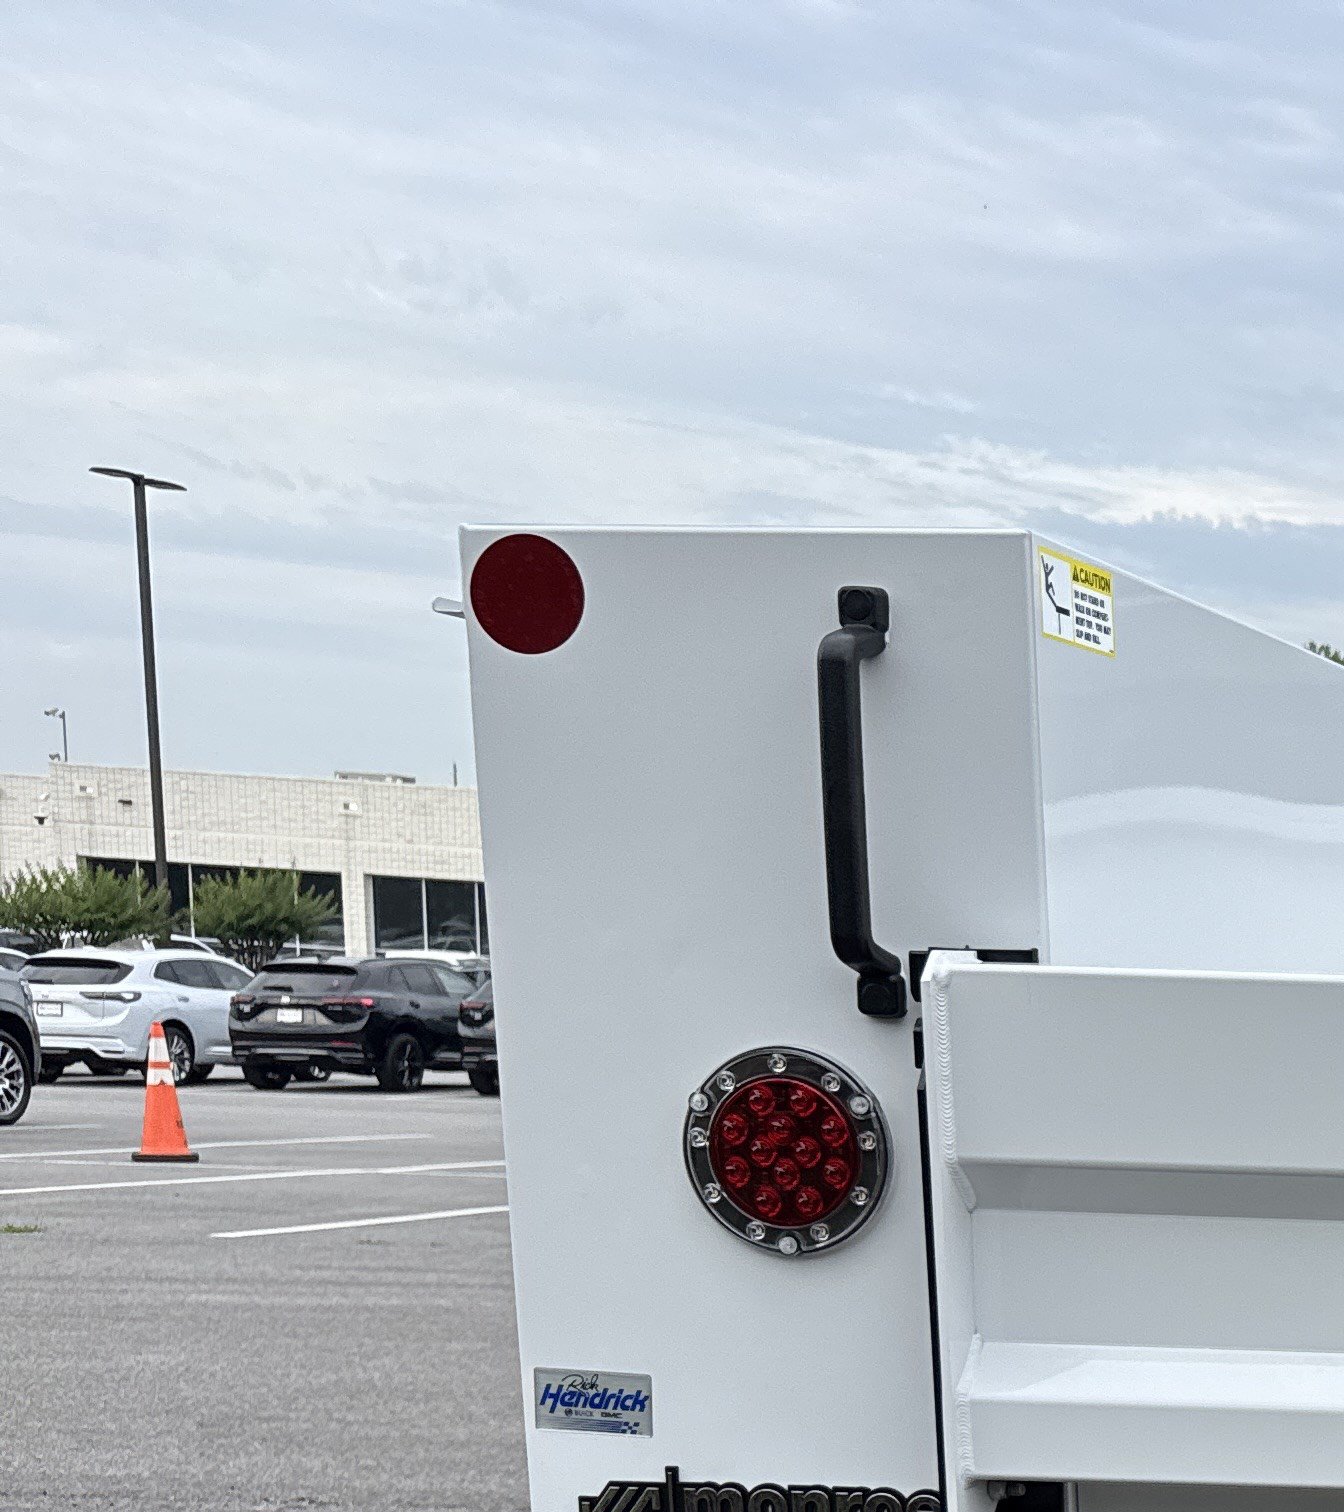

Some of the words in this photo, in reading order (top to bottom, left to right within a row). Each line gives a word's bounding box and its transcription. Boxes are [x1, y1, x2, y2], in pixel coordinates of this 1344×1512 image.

[1079, 567, 1111, 594] CAUTION
[539, 1383, 650, 1414] Hendrick
[562, 1373, 600, 1397] Rick
